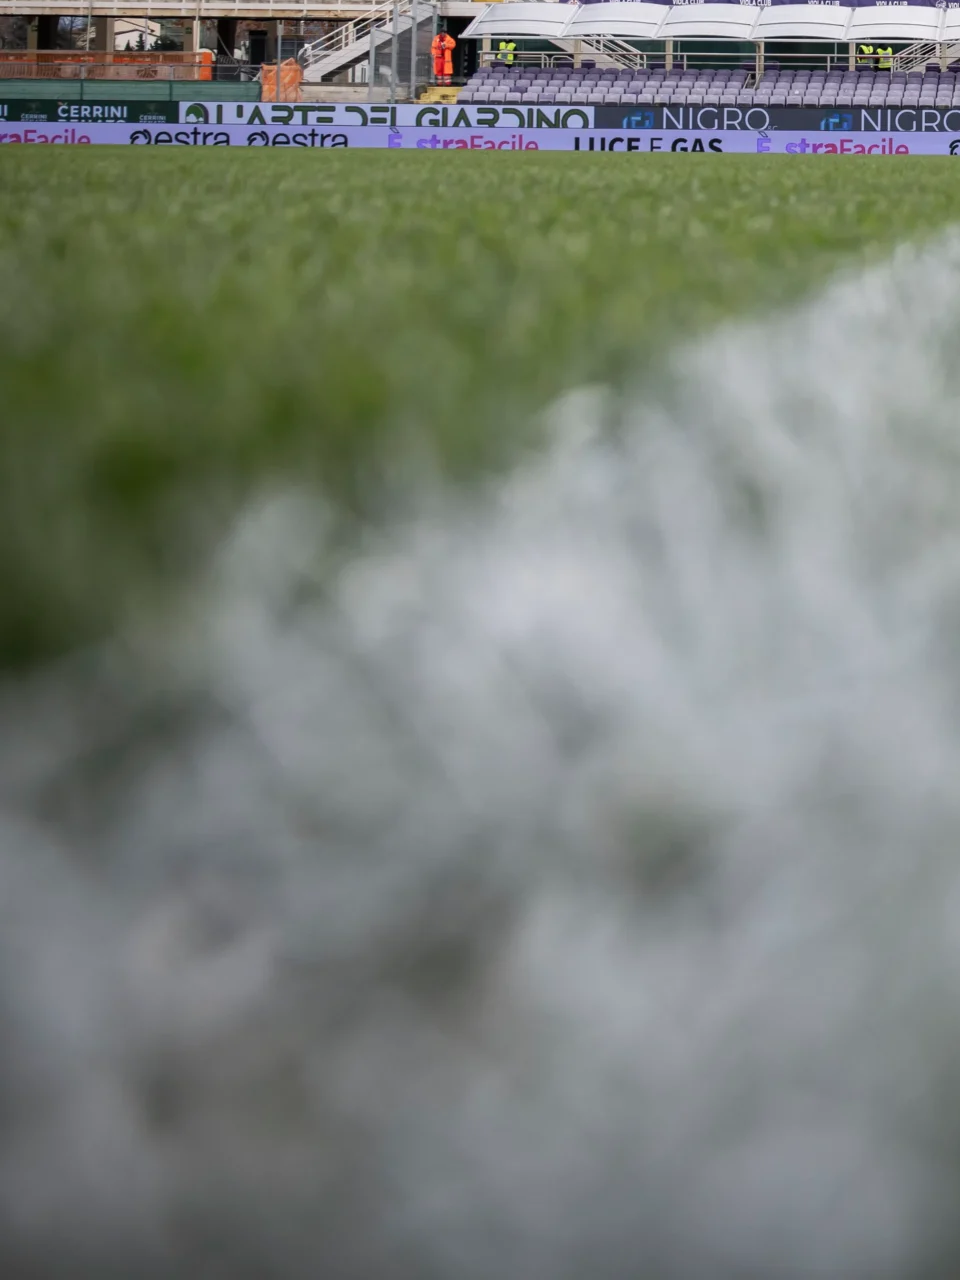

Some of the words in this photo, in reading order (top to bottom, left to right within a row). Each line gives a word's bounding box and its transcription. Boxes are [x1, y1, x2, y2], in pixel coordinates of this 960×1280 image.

[740, 0, 756, 7] VIOLA
[757, 0, 772, 7] CLUB
[416, 107, 589, 129] GIARDINO
[662, 107, 770, 131] NIGRO
[671, 137, 723, 153] GAS
